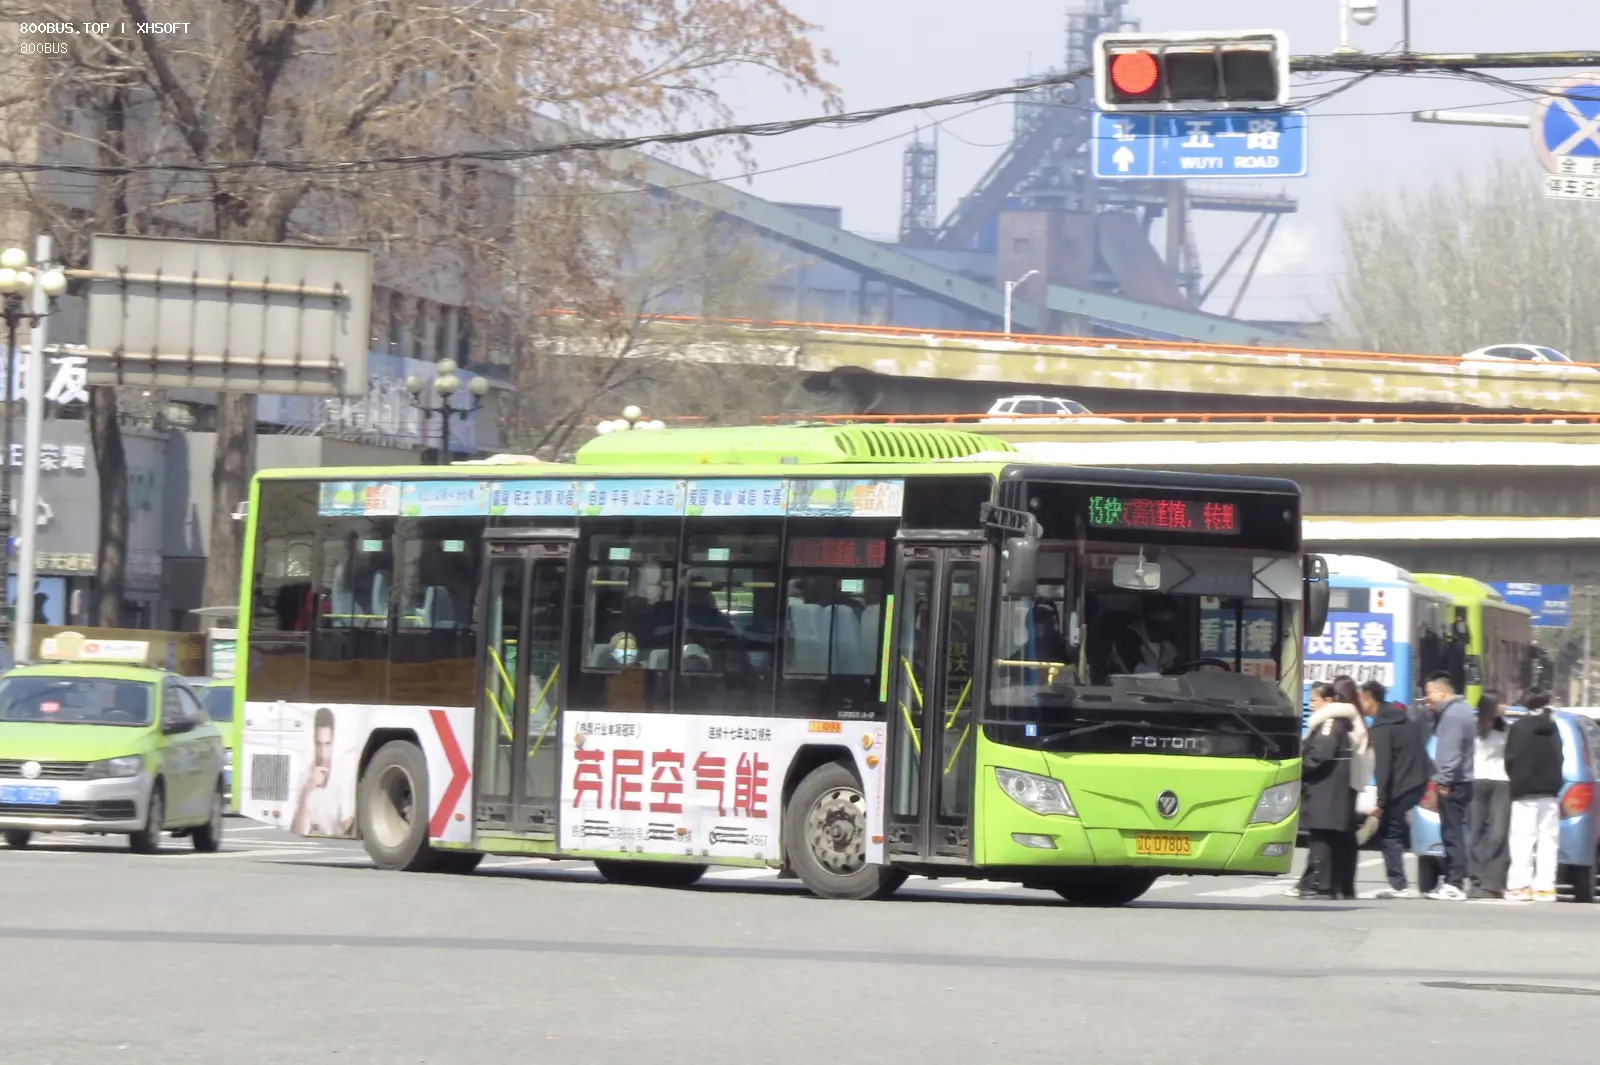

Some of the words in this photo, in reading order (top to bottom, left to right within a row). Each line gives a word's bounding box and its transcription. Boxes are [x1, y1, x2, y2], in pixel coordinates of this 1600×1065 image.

[1181, 120, 1281, 150] 五一路
[1180, 156, 1223, 169] WUYI
[1233, 155, 1280, 169] ROAD
[1131, 736, 1197, 749] FOTON
[572, 748, 770, 820] 芬尼空气能
